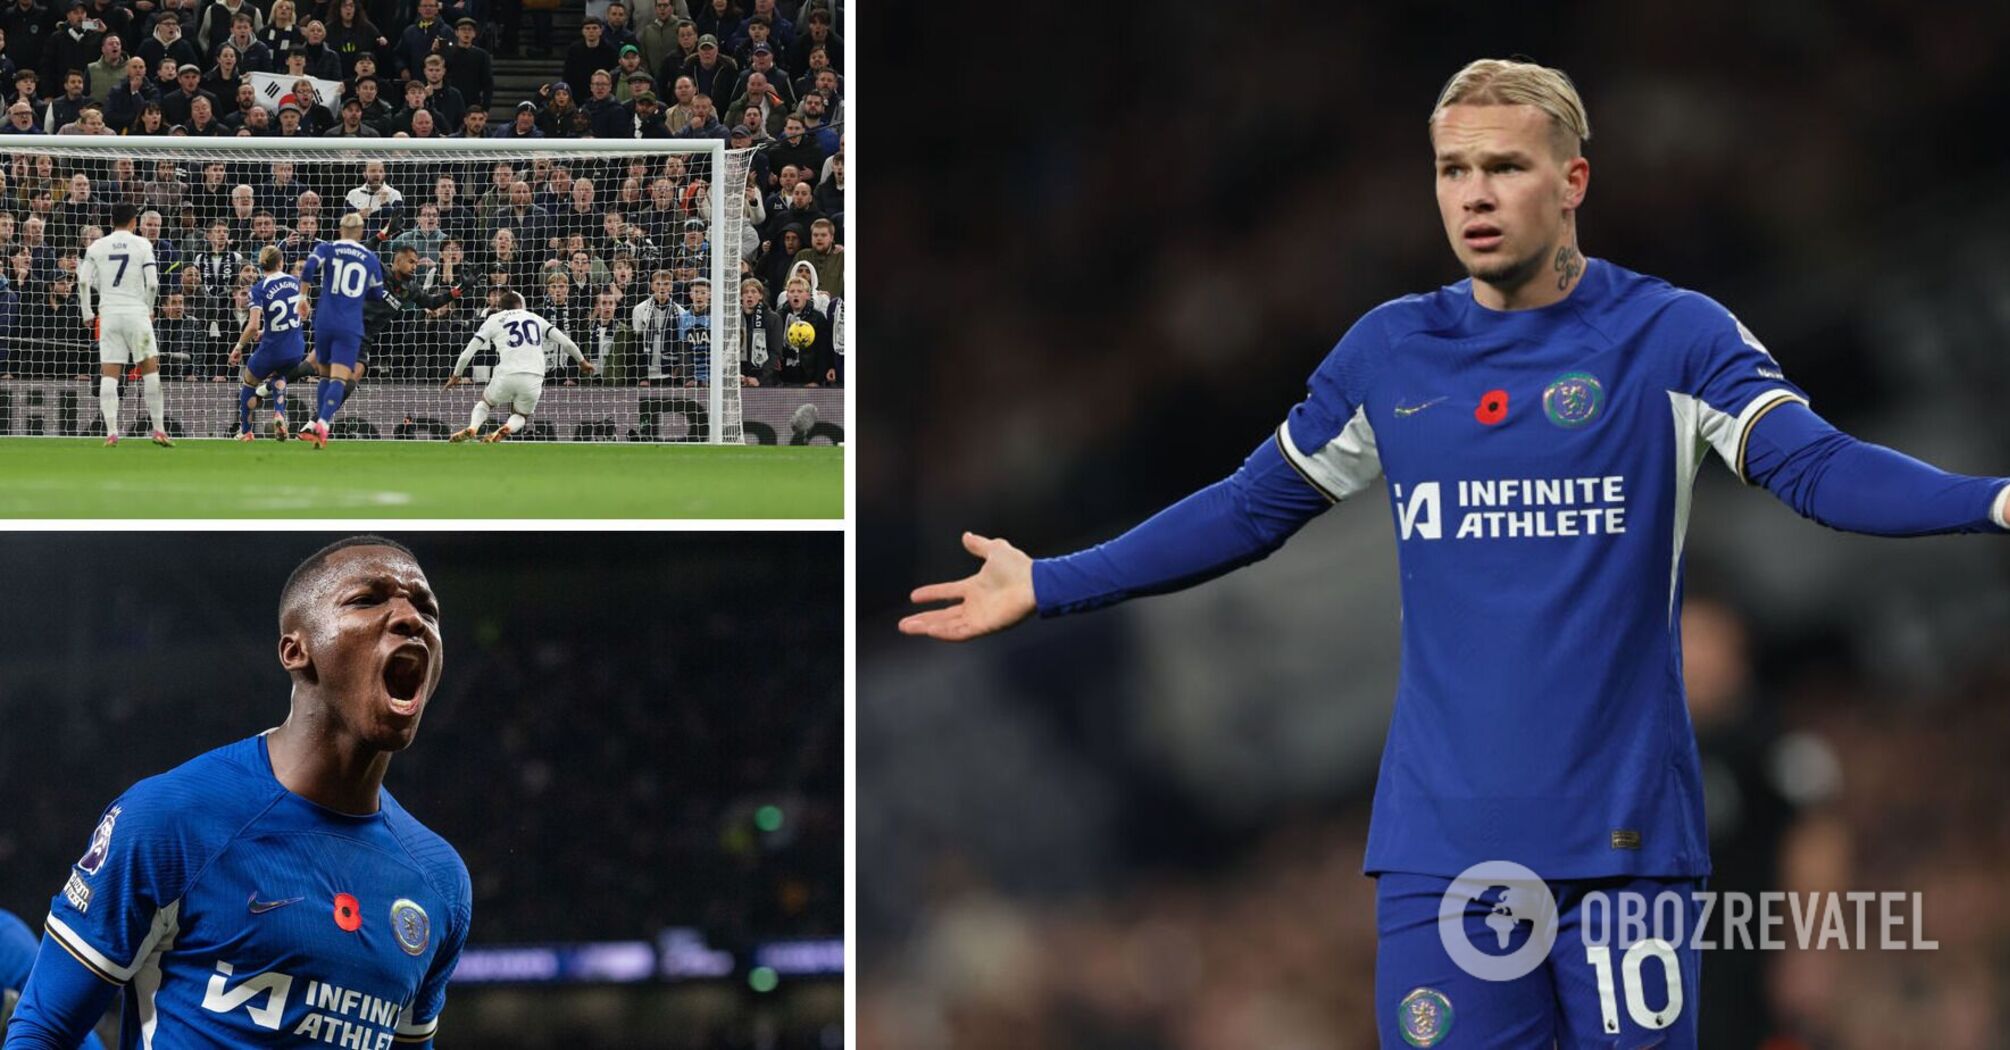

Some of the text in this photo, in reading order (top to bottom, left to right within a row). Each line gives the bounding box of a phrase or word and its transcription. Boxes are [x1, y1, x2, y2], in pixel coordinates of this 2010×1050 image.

[108, 253, 130, 288] 7
[331, 258, 368, 298] 10
[503, 318, 542, 348] 30
[1458, 475, 1625, 507] INFINITE
[1455, 507, 1627, 539] ATHLETE
[1586, 938, 1684, 1034] 10
